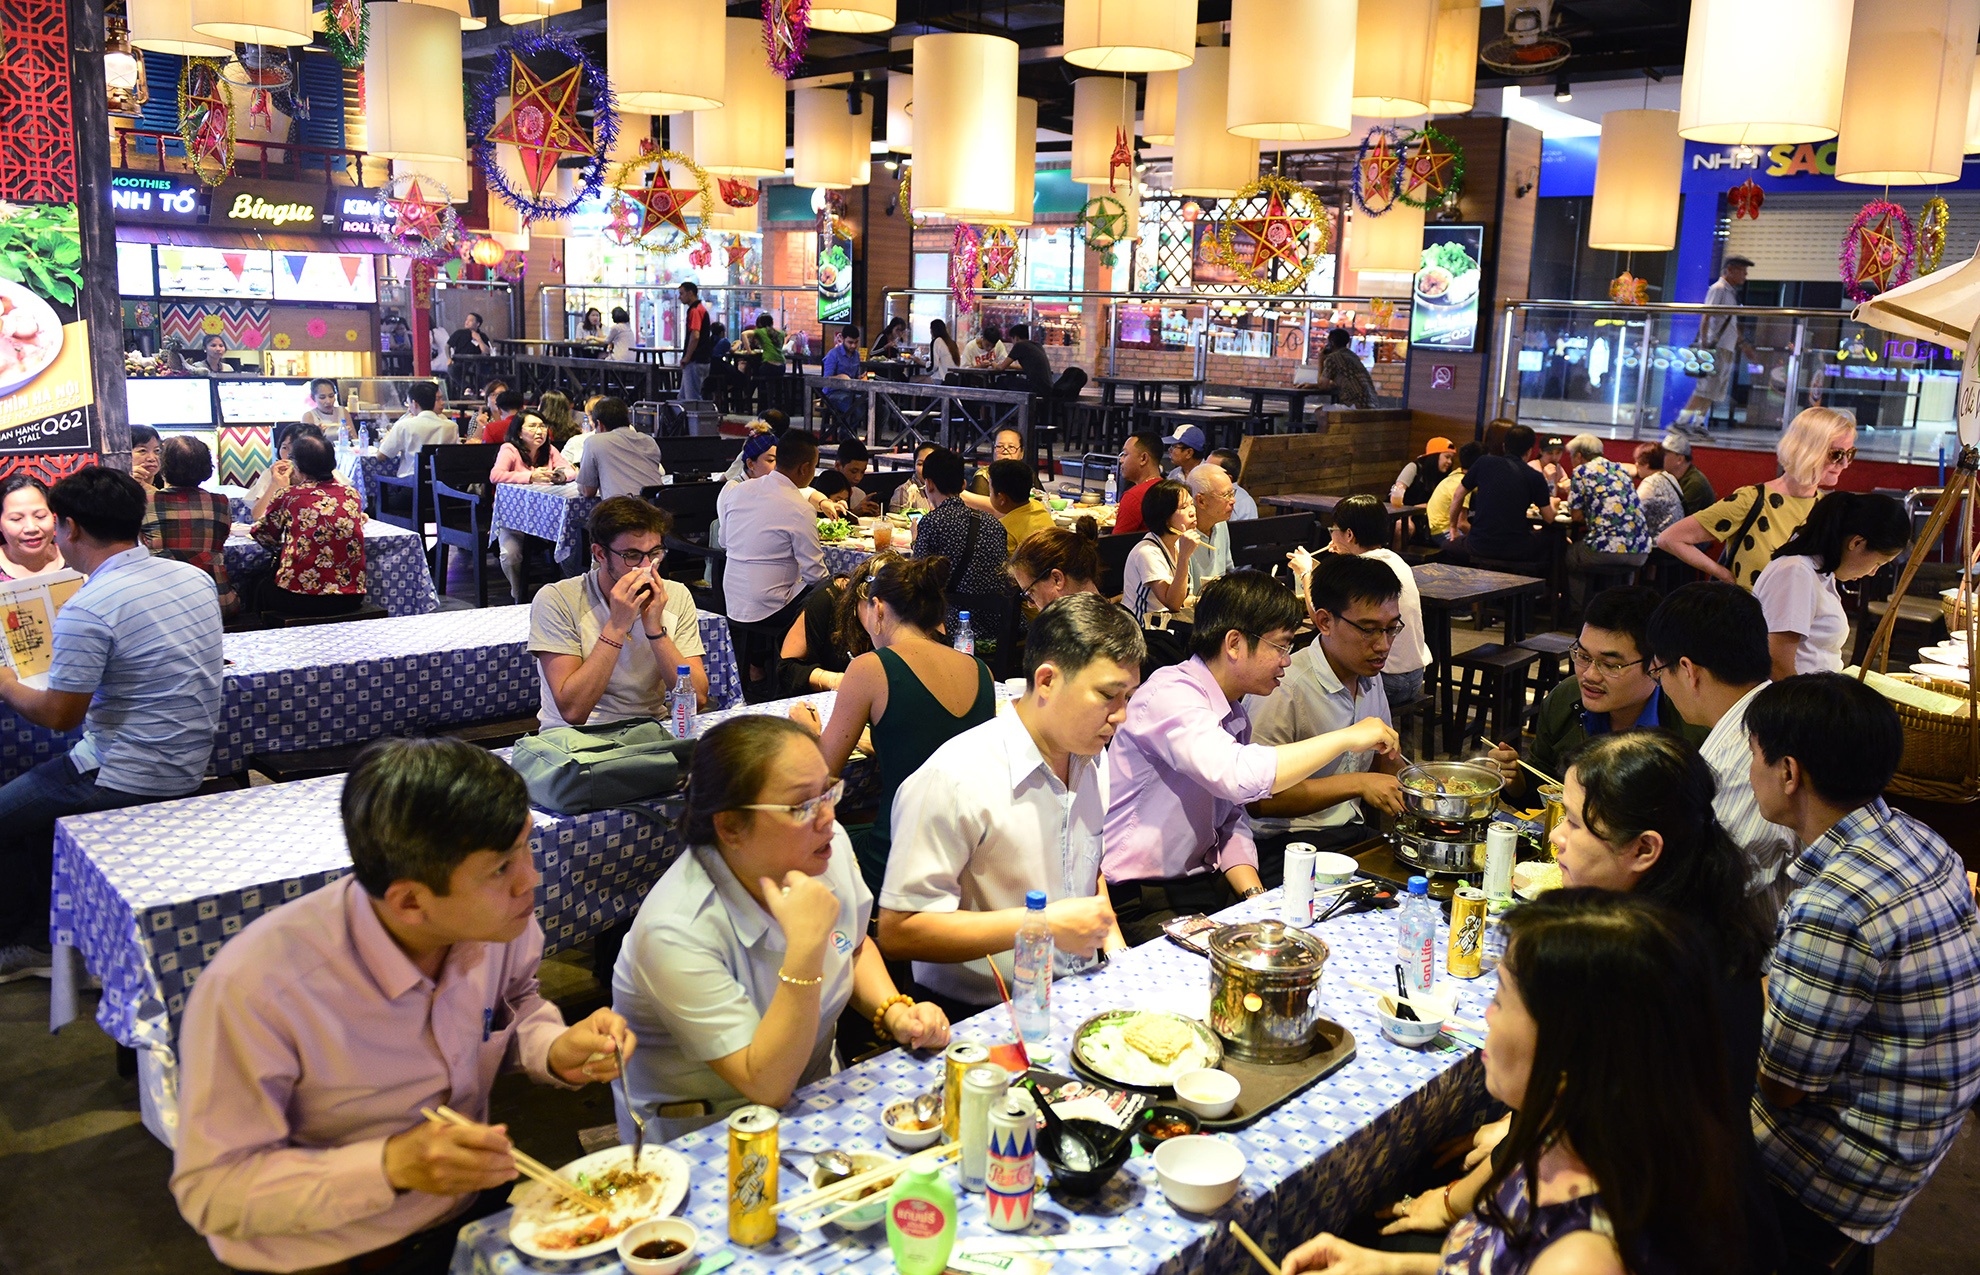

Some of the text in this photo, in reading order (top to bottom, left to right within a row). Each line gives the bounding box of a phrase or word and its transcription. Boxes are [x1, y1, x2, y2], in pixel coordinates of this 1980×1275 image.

[159, 188, 196, 213] TỐ
[228, 193, 315, 226] Bingsu
[343, 199, 381, 216] KEM
[342, 221, 371, 234] ROLL
[15, 403, 54, 420] NOODLE
[57, 395, 81, 409] SOUP
[15, 422, 40, 437] HÀNG
[41, 410, 83, 435] Q62
[18, 432, 41, 445] STALL
[677, 703, 685, 720] Life
[1421, 938, 1432, 963] Life
